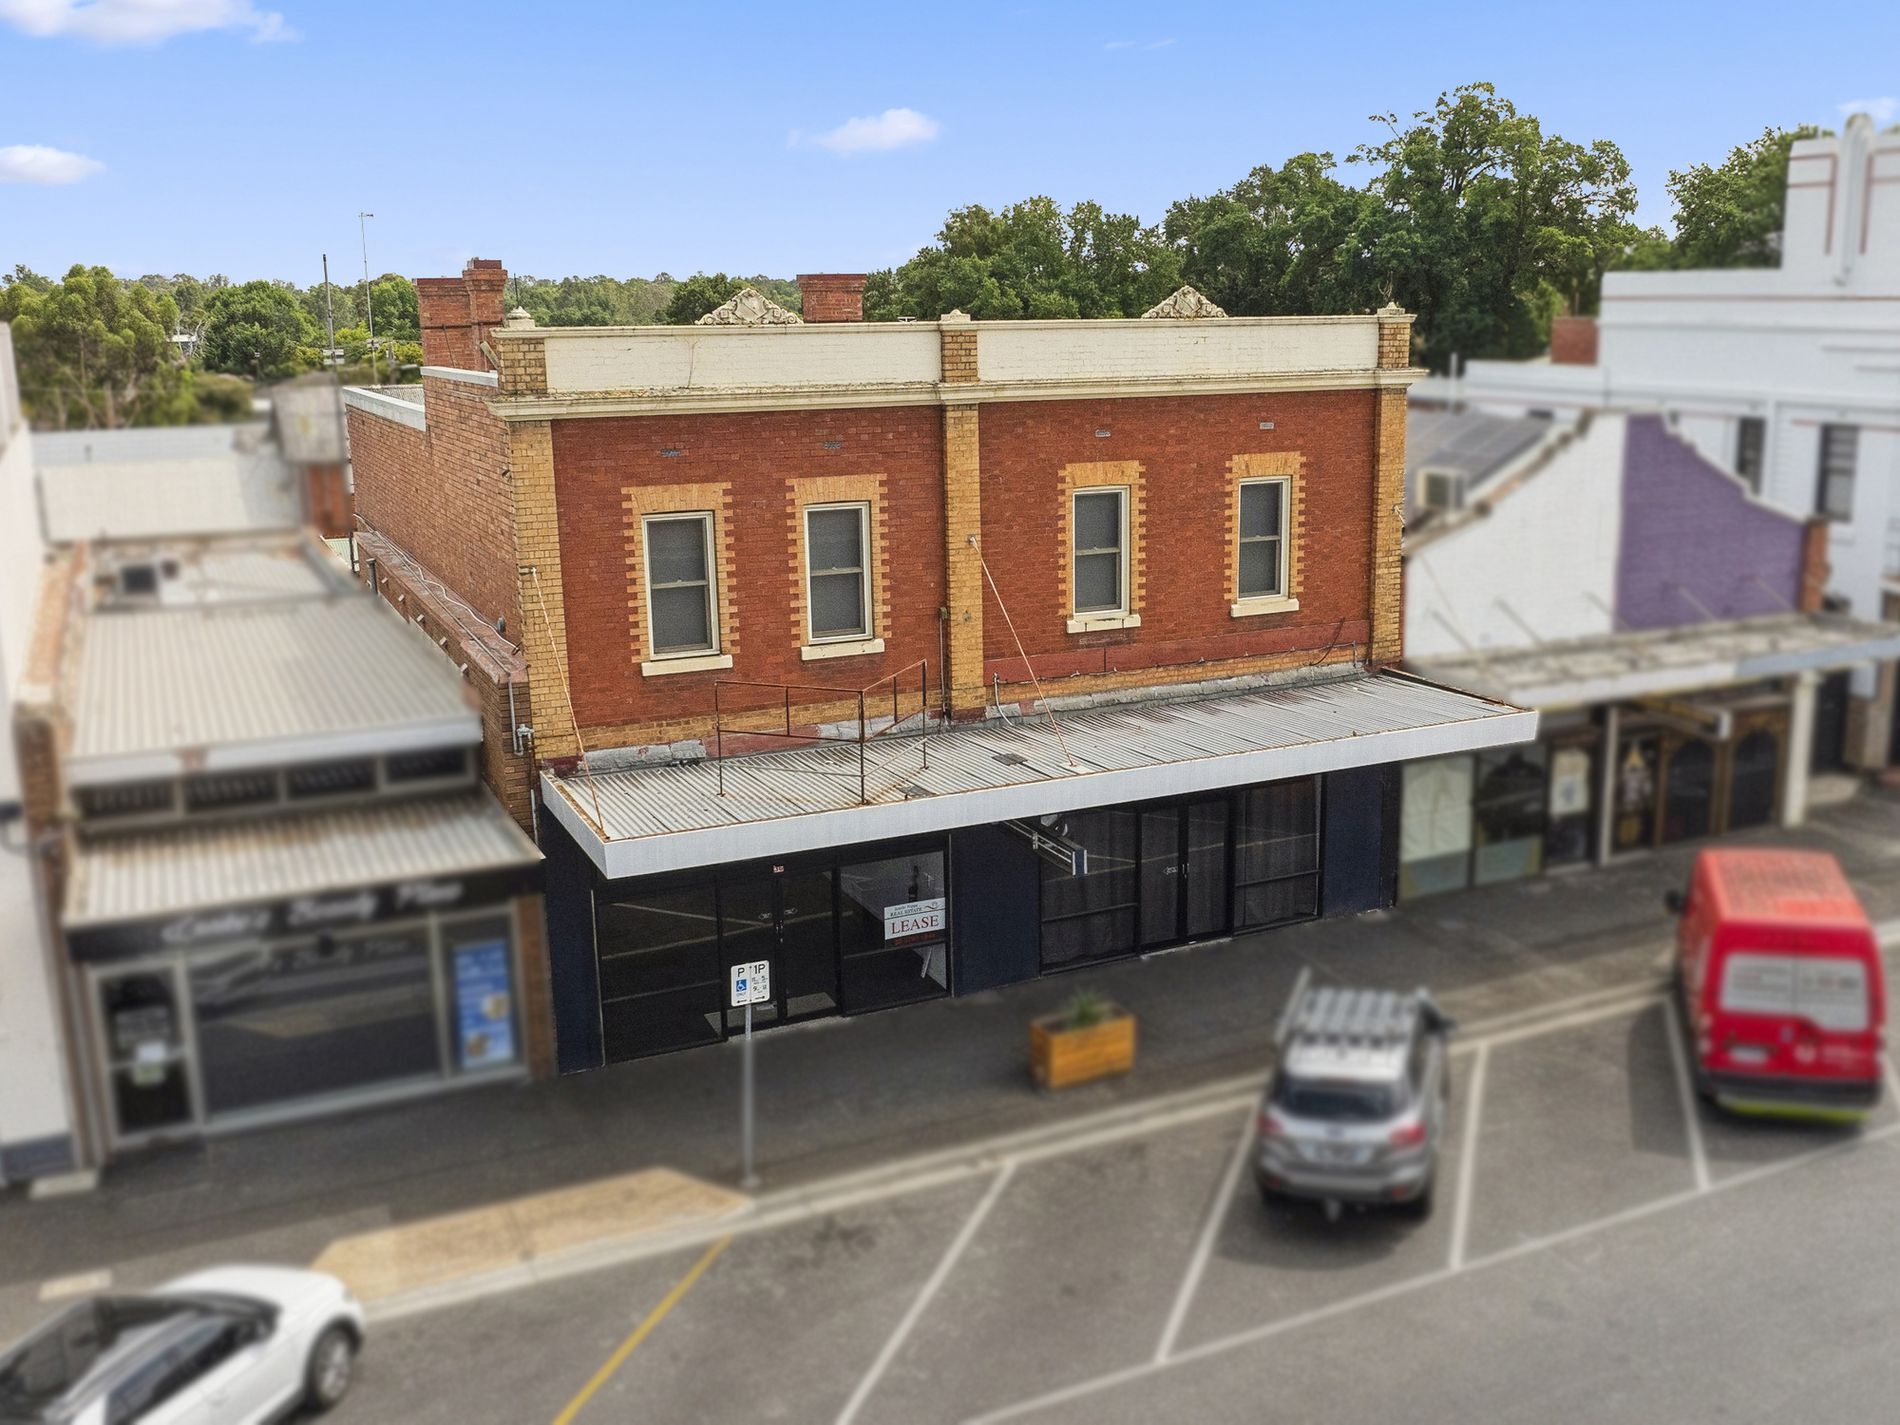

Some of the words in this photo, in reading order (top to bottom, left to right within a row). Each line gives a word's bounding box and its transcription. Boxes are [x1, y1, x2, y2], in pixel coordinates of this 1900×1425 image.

[892, 915, 939, 934] LEASE
[737, 967, 745, 977] P
[754, 963, 766, 974] 1P
